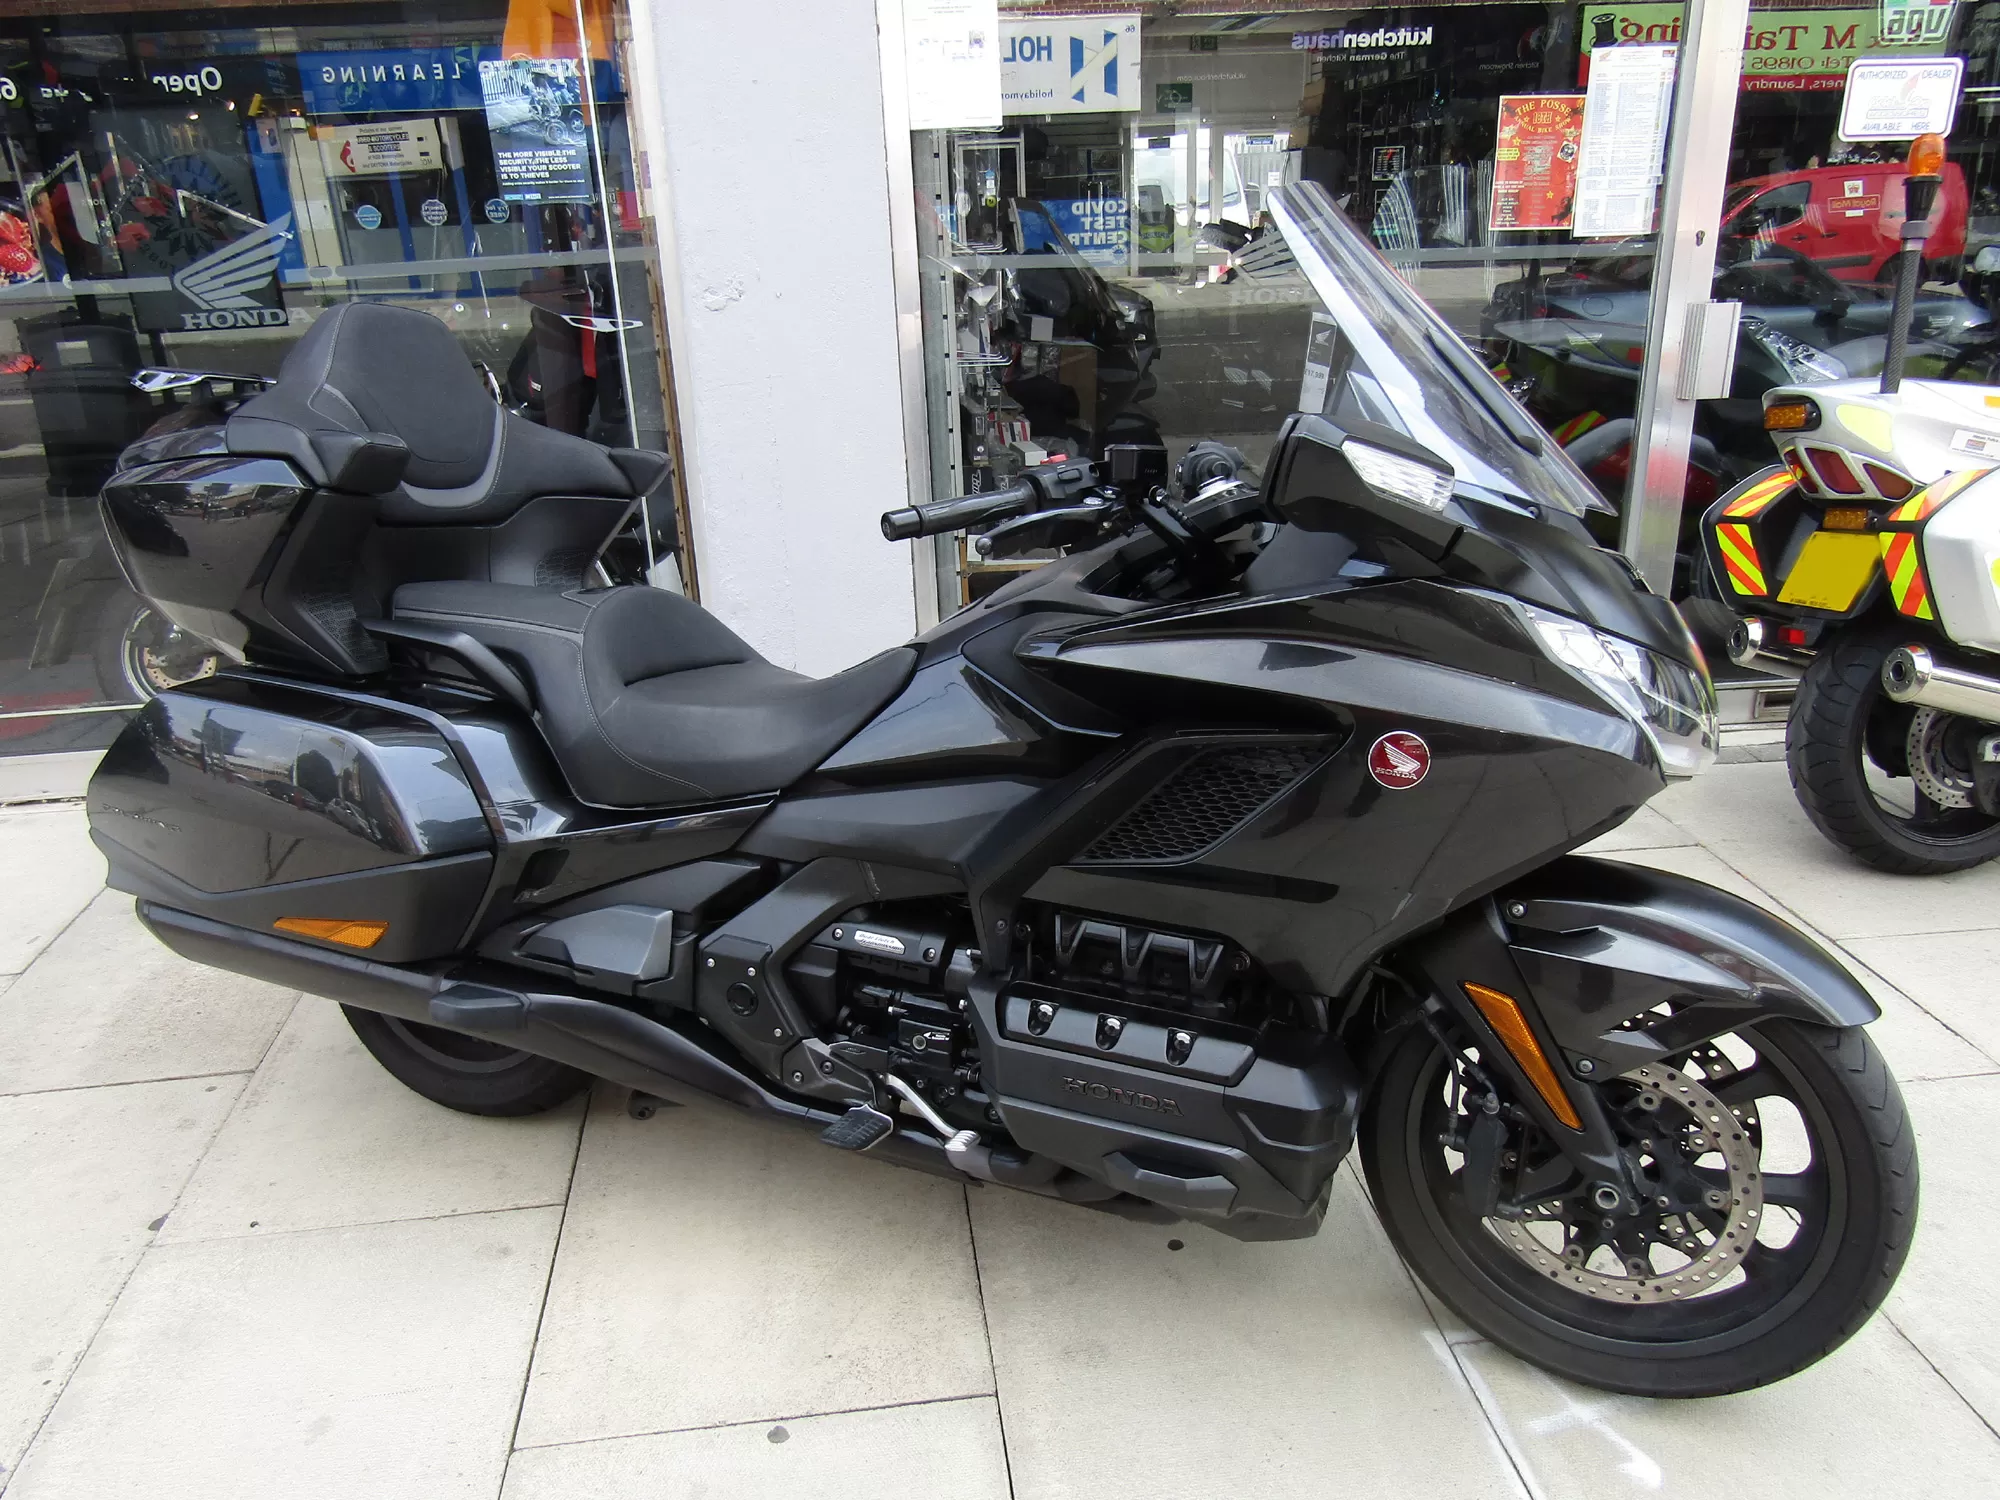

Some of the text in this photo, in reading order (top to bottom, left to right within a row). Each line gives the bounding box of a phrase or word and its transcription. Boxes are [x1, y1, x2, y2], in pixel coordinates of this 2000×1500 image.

[1857, 69, 1952, 80] AUTHORIZED DEALER
[1515, 99, 1572, 116] THE POSSE
[1861, 121, 1931, 131] AVAILABLE HERE
[534, 150, 563, 158] VISIBLE
[548, 163, 581, 171] SCOOTER
[181, 307, 315, 330] HONDA
[1374, 766, 1418, 780] HONDA
[1062, 1076, 1185, 1117] HONDA
